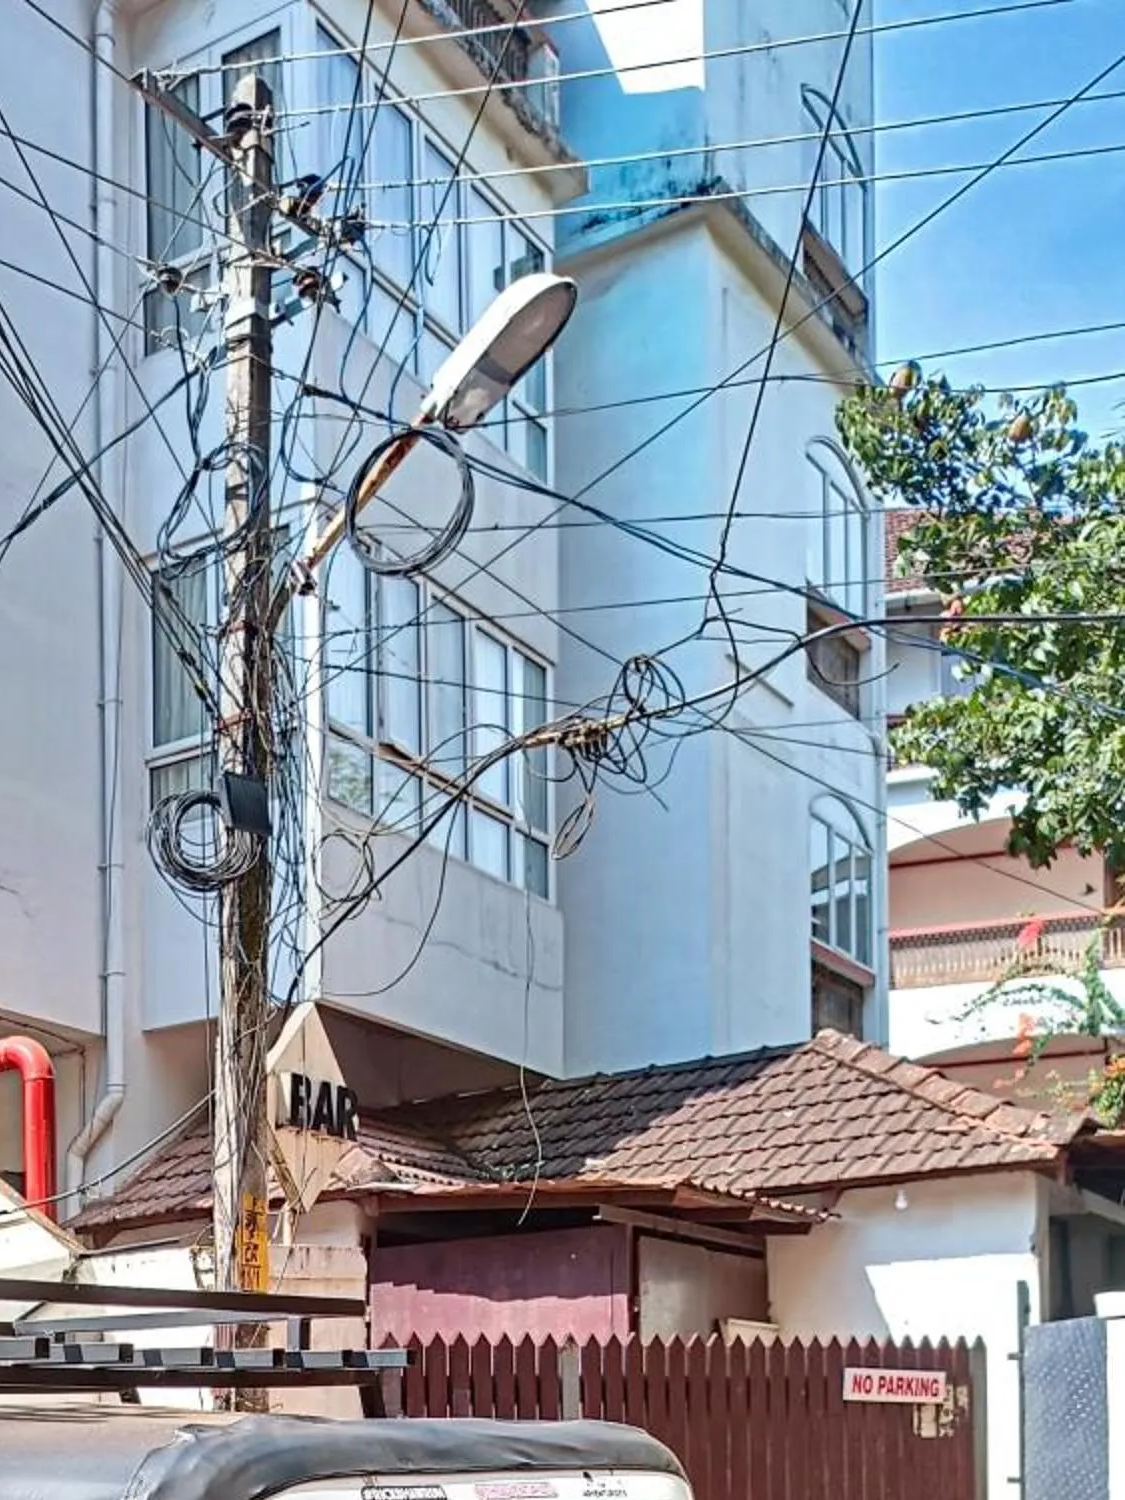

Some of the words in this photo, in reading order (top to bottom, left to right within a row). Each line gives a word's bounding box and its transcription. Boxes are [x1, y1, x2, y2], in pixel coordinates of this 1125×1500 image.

[290, 1072, 358, 1141] BAR
[852, 1375, 873, 1394] NO
[877, 1376, 940, 1397] PARKING
